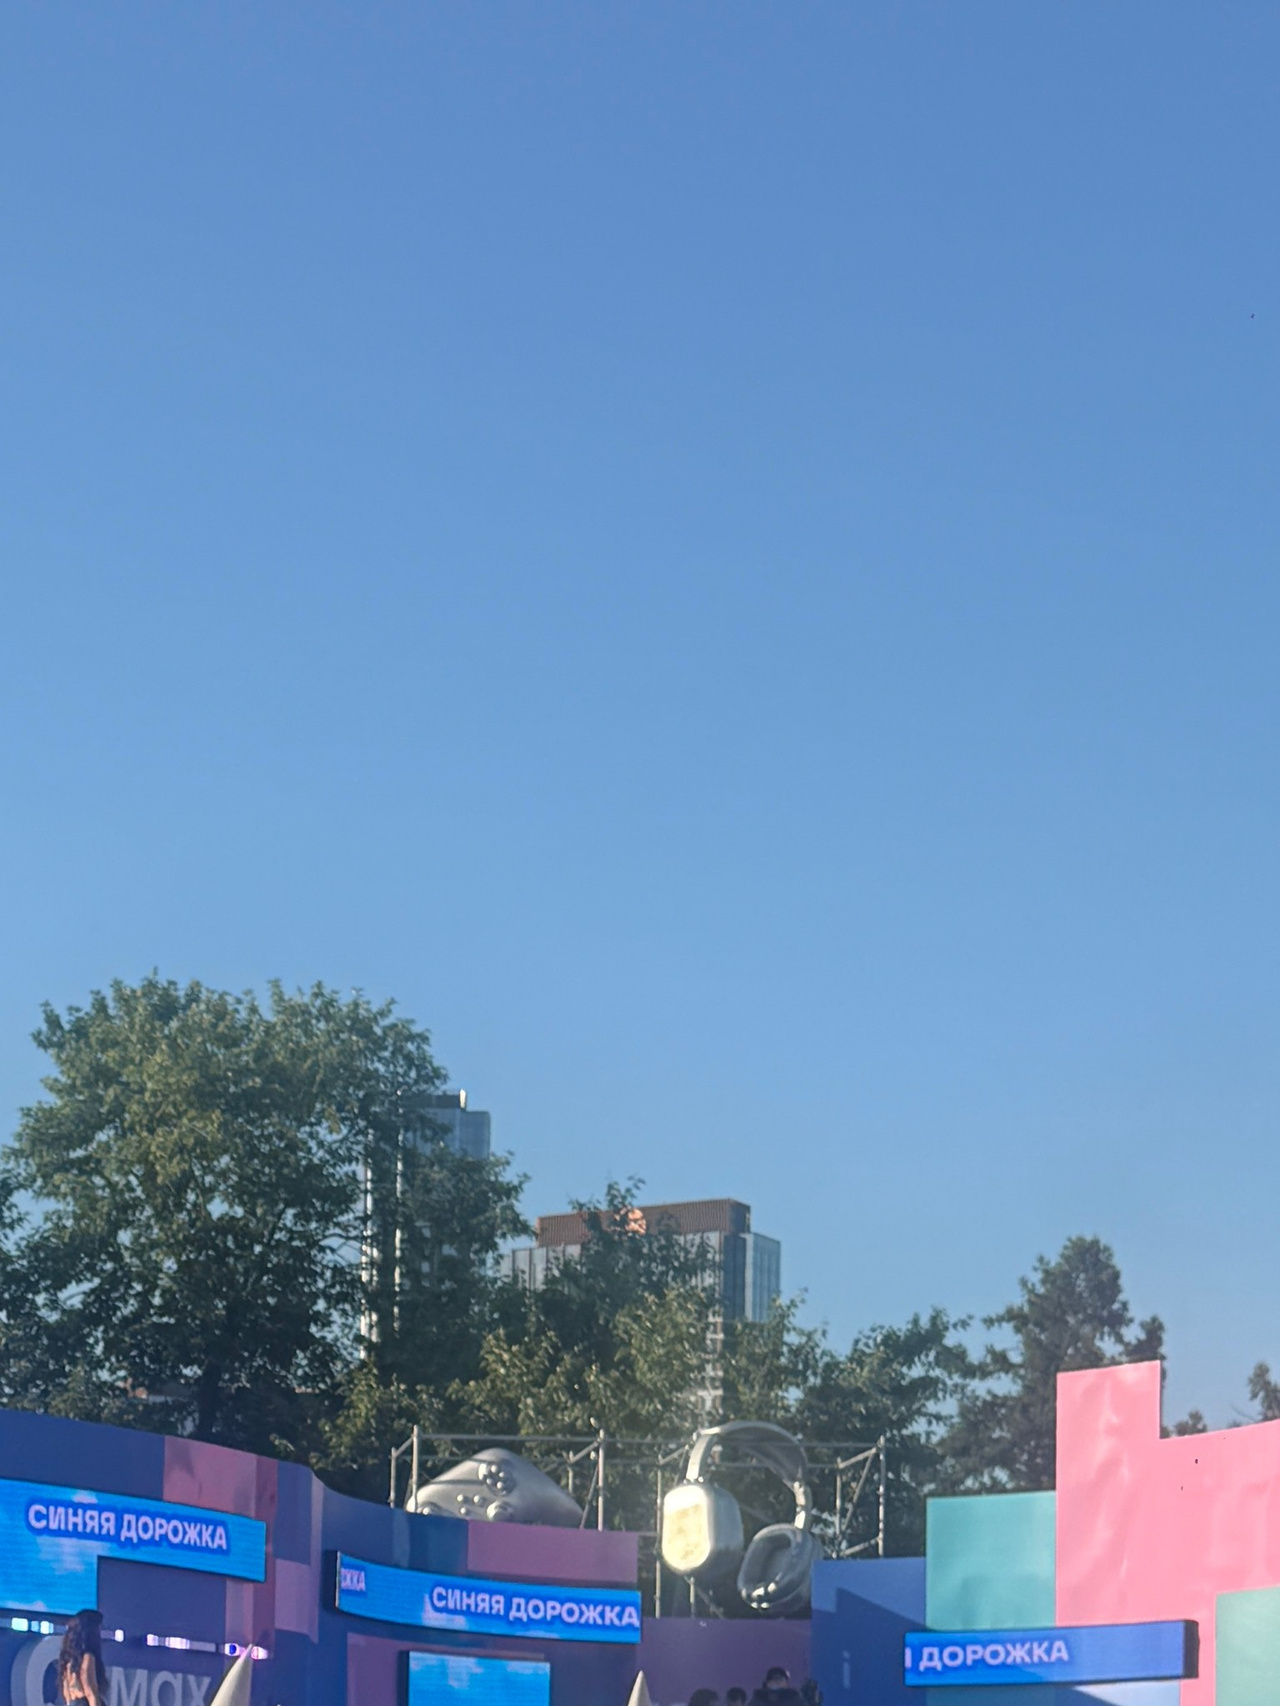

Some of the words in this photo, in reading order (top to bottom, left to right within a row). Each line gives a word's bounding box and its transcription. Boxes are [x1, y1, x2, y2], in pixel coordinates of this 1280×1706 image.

[28, 1504, 116, 1536] СИНЯЯ
[120, 1514, 227, 1550] ДОРОЖКА
[432, 1586, 504, 1616] СИНЯЯ
[509, 1598, 640, 1628] ДОРОЖКА
[920, 1640, 1069, 1671] ДОРОЖКА
